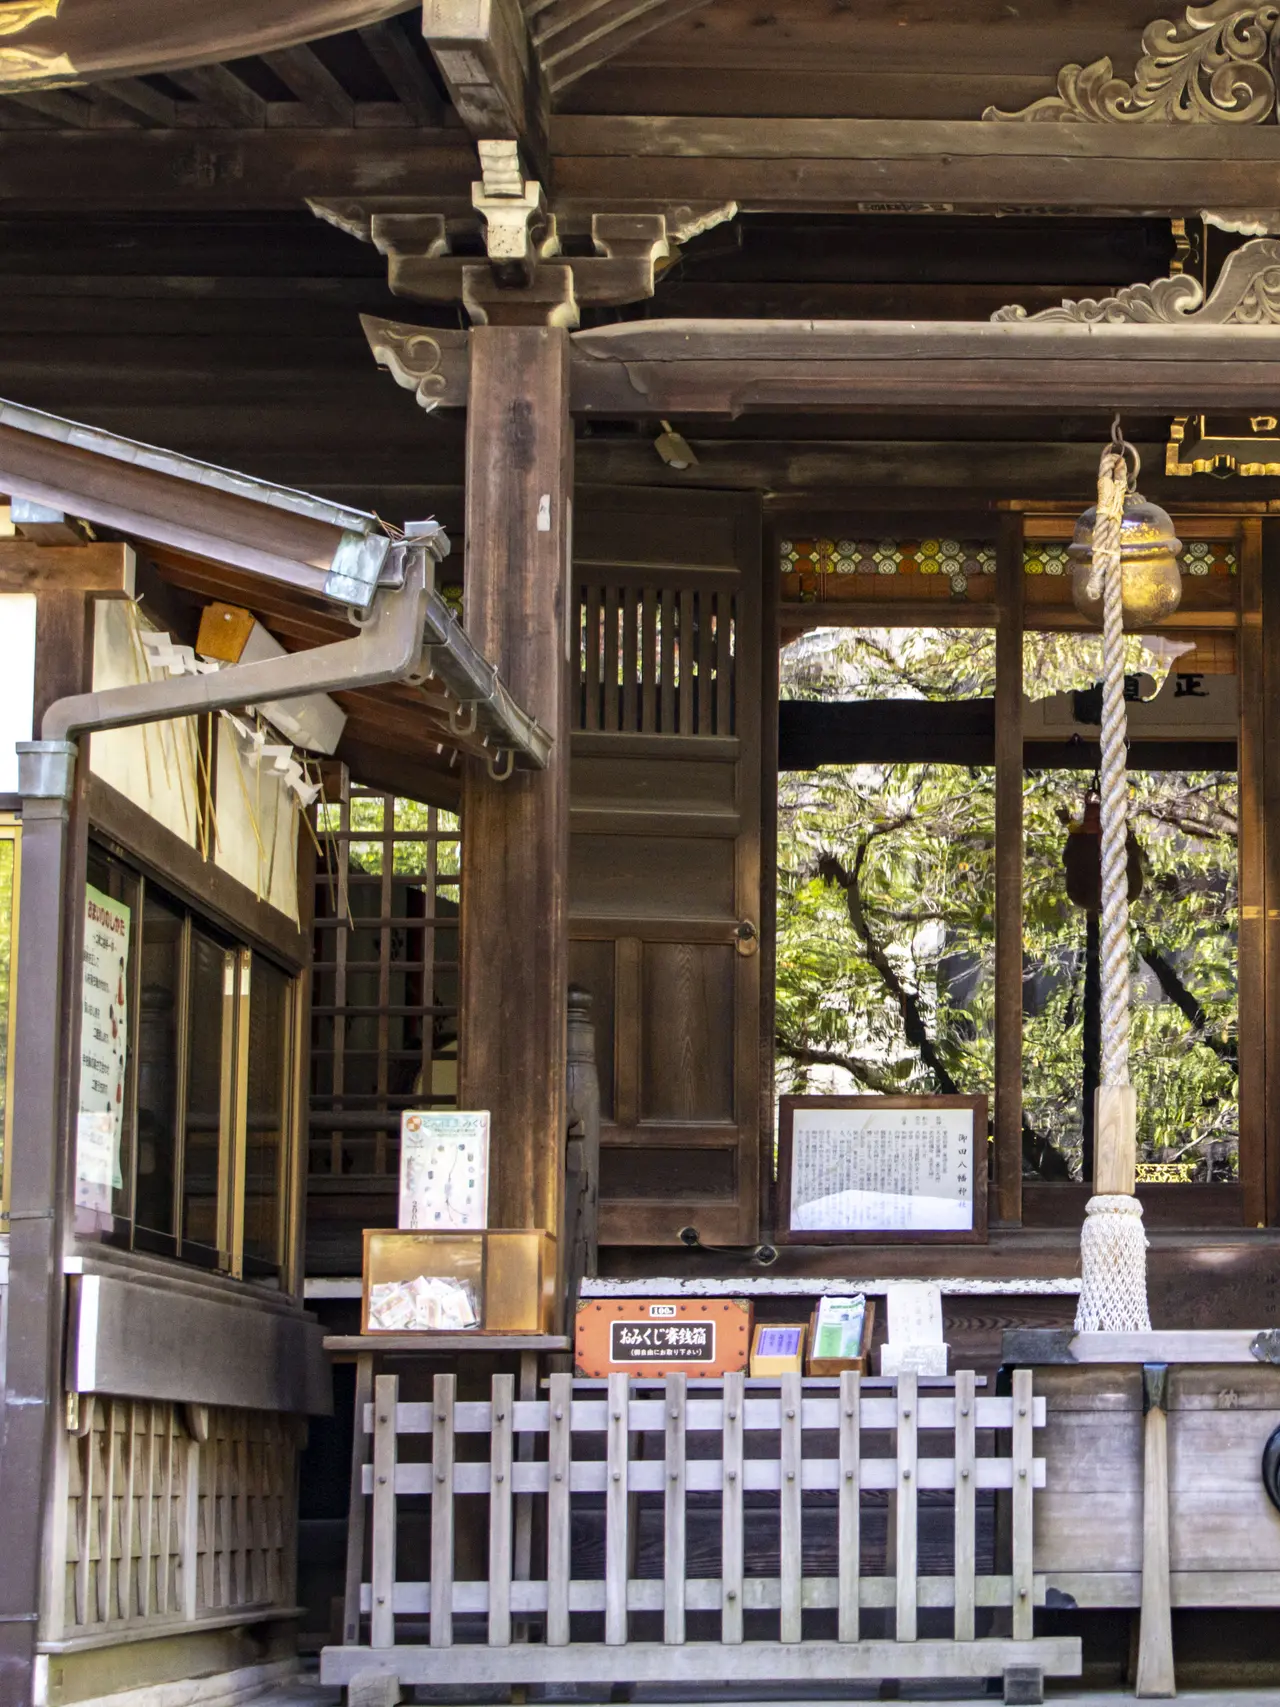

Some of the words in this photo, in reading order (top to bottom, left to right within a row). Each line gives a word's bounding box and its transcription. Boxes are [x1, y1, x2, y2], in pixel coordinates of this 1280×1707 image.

[619, 1327, 707, 1347] おみくじ賽銭箱
